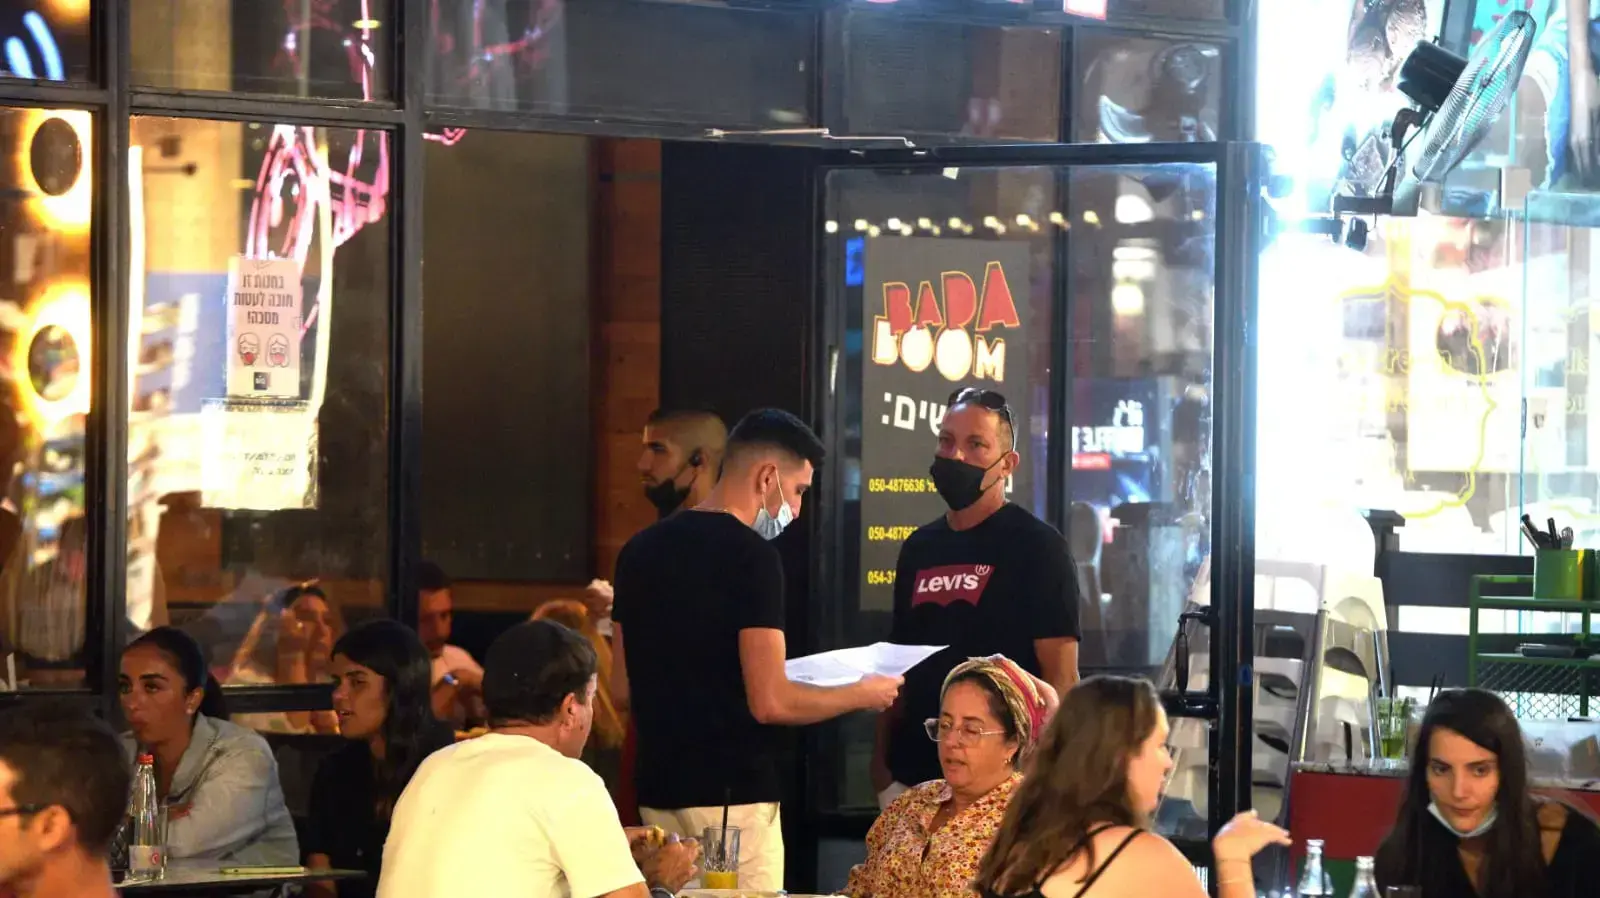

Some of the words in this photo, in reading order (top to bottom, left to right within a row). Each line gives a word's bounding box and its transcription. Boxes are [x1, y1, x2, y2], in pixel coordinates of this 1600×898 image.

[254, 274, 284, 289] בחנות
[233, 290, 266, 307] לעטות
[268, 293, 293, 308] חובה
[883, 261, 1020, 335] BADA
[247, 310, 280, 325] מסכה!
[872, 315, 1006, 382] BOOM
[881, 391, 947, 437] שים:
[868, 525, 919, 541] 050-4876
